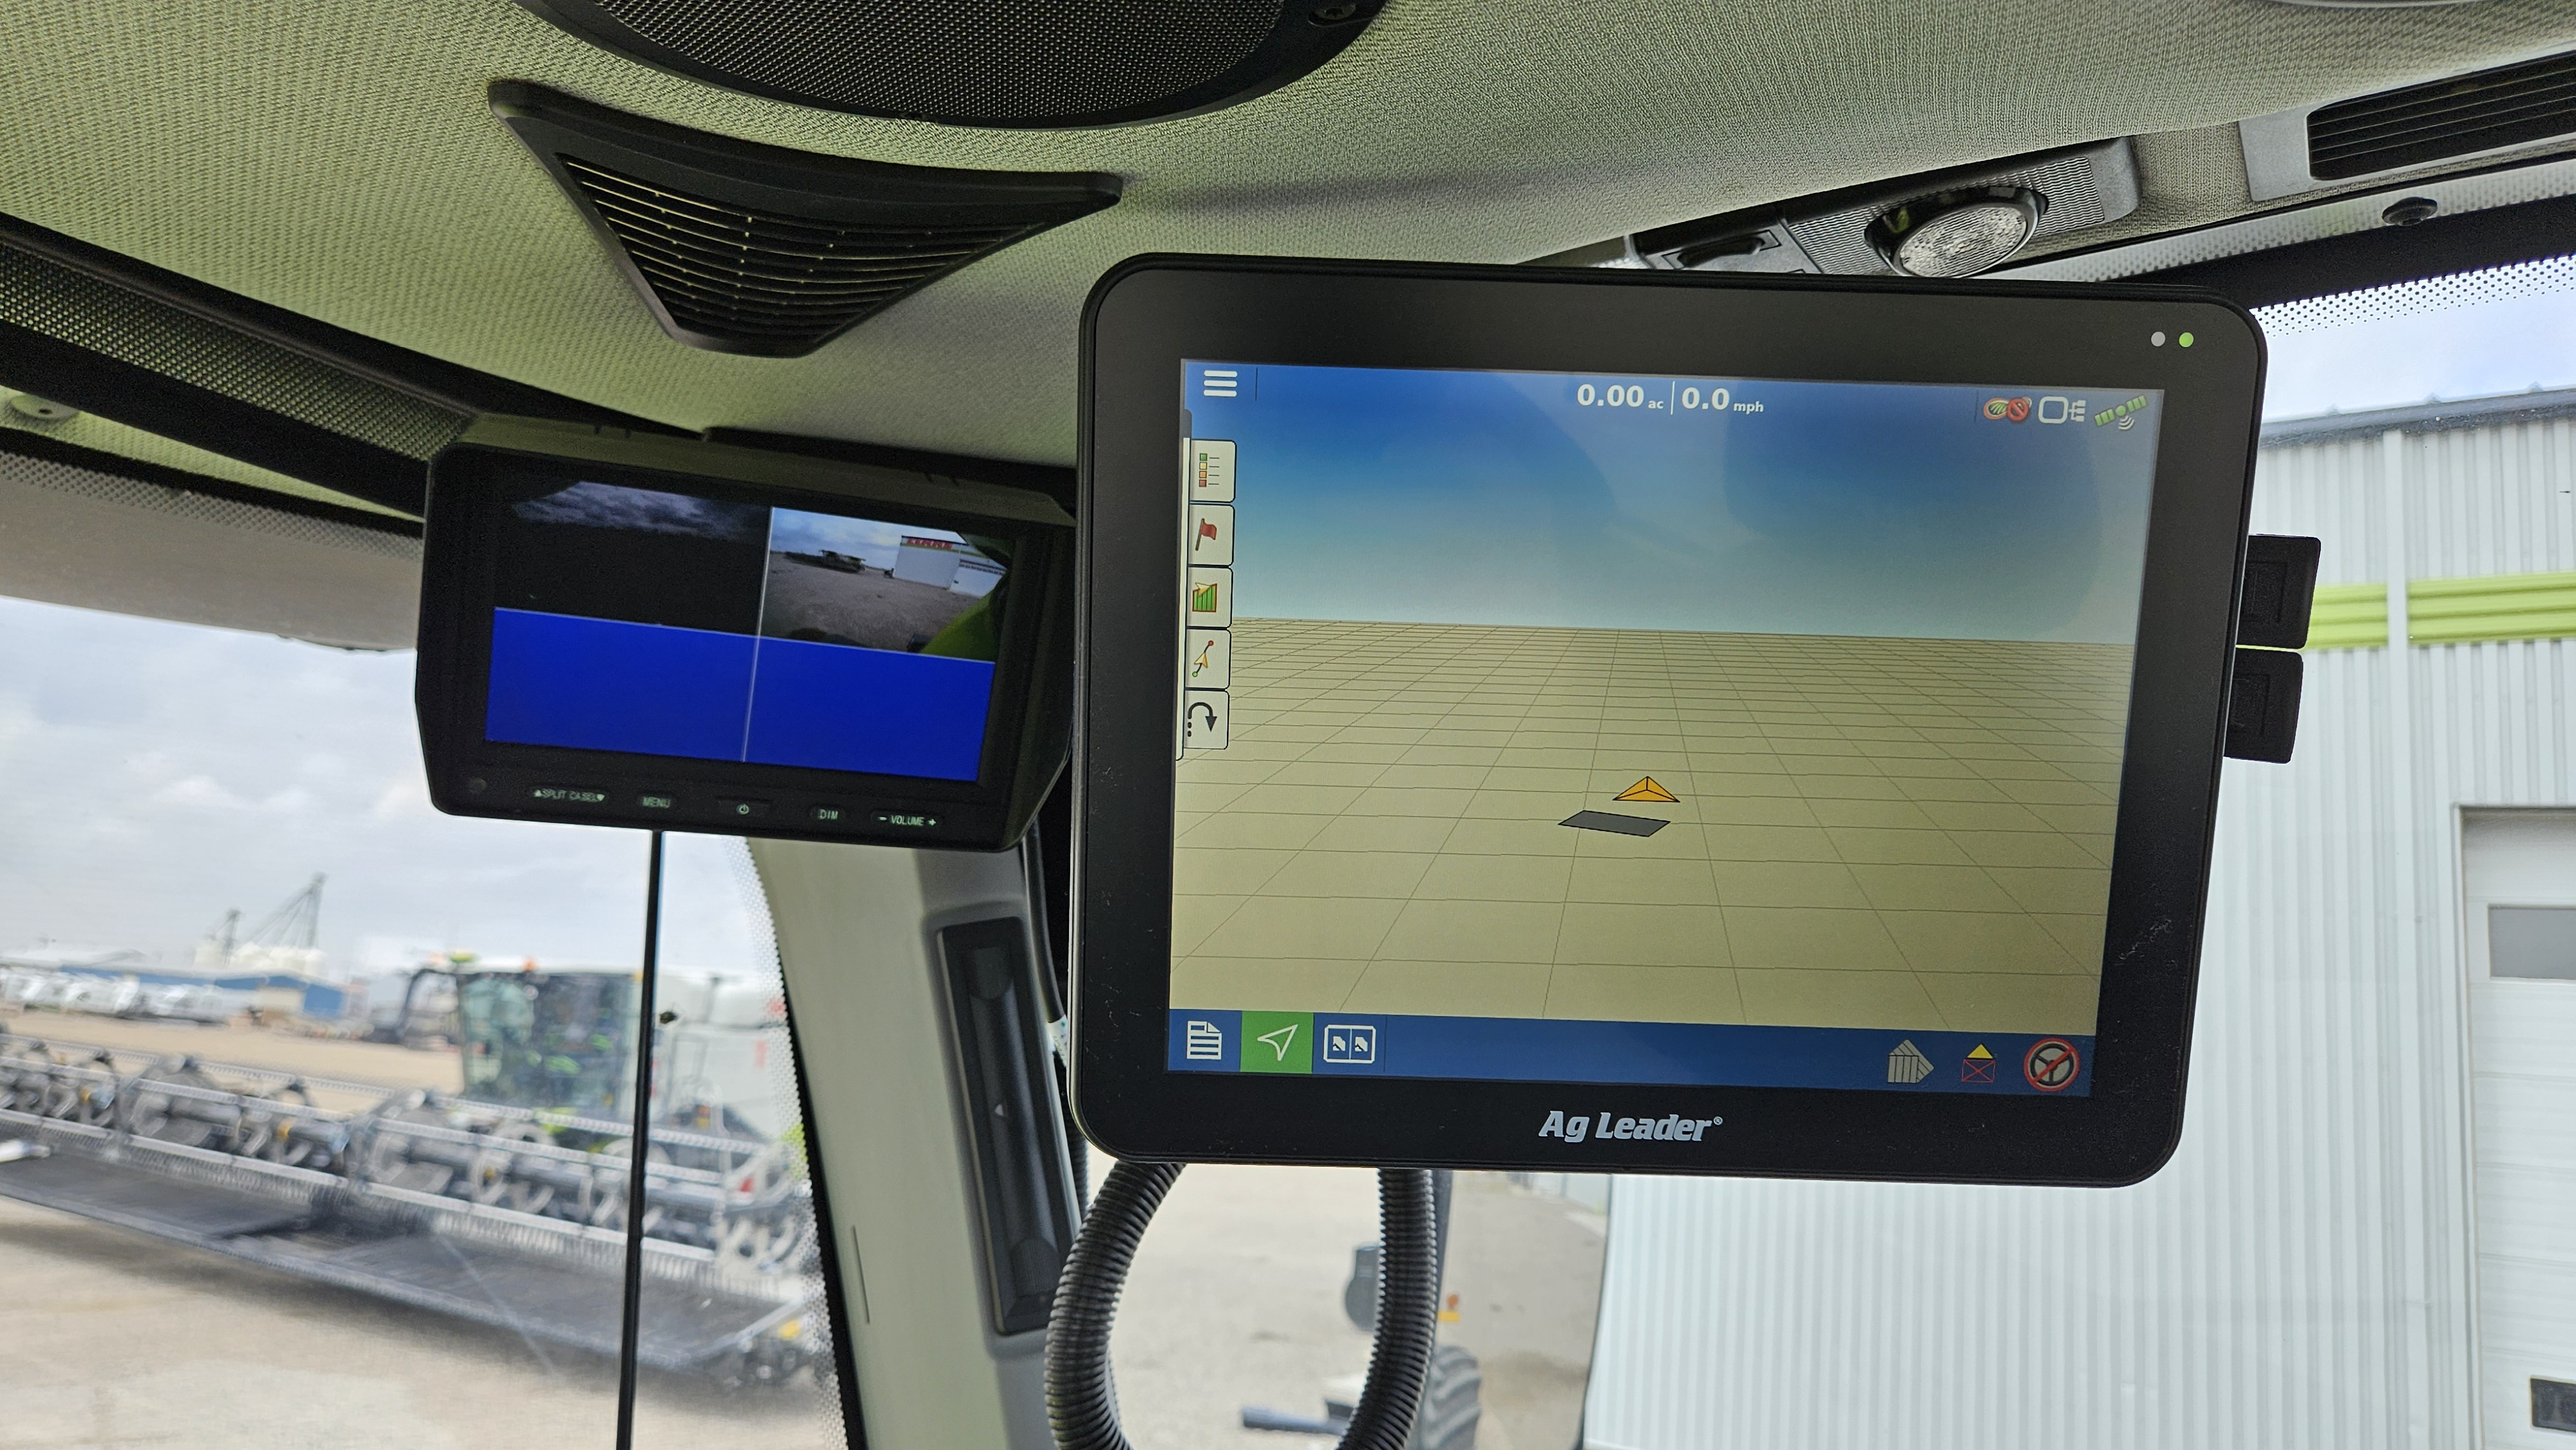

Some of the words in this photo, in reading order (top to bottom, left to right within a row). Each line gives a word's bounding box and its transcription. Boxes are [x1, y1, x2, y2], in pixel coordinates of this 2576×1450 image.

[1578, 384, 1643, 407] 0.00
[1648, 399, 1663, 409] ac
[1682, 387, 1730, 410] 0.0
[1733, 401, 1764, 414] mph
[643, 796, 670, 809] MENU
[819, 809, 838, 820] DIM
[891, 815, 924, 826] VOLUME
[1539, 1111, 1590, 1143] Ag
